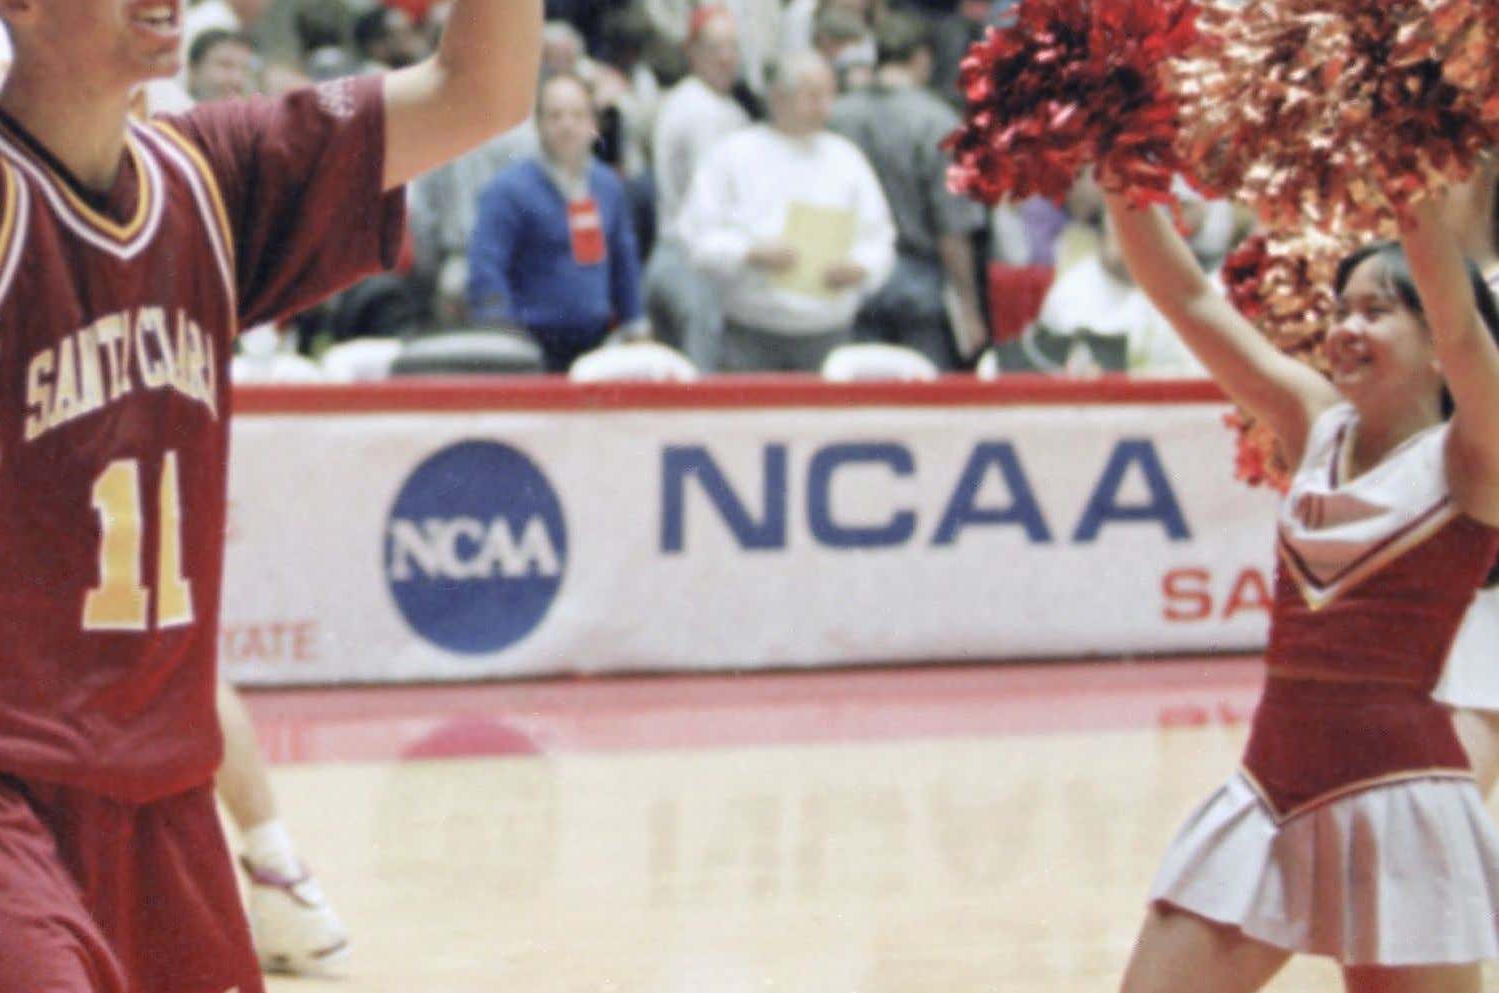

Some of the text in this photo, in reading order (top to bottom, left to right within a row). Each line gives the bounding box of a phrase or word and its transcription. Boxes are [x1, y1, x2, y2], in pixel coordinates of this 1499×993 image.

[24, 309, 132, 441] SANTA
[82, 450, 194, 630] 11
[389, 512, 560, 580] NCAA
[659, 437, 1192, 553] NCAA
